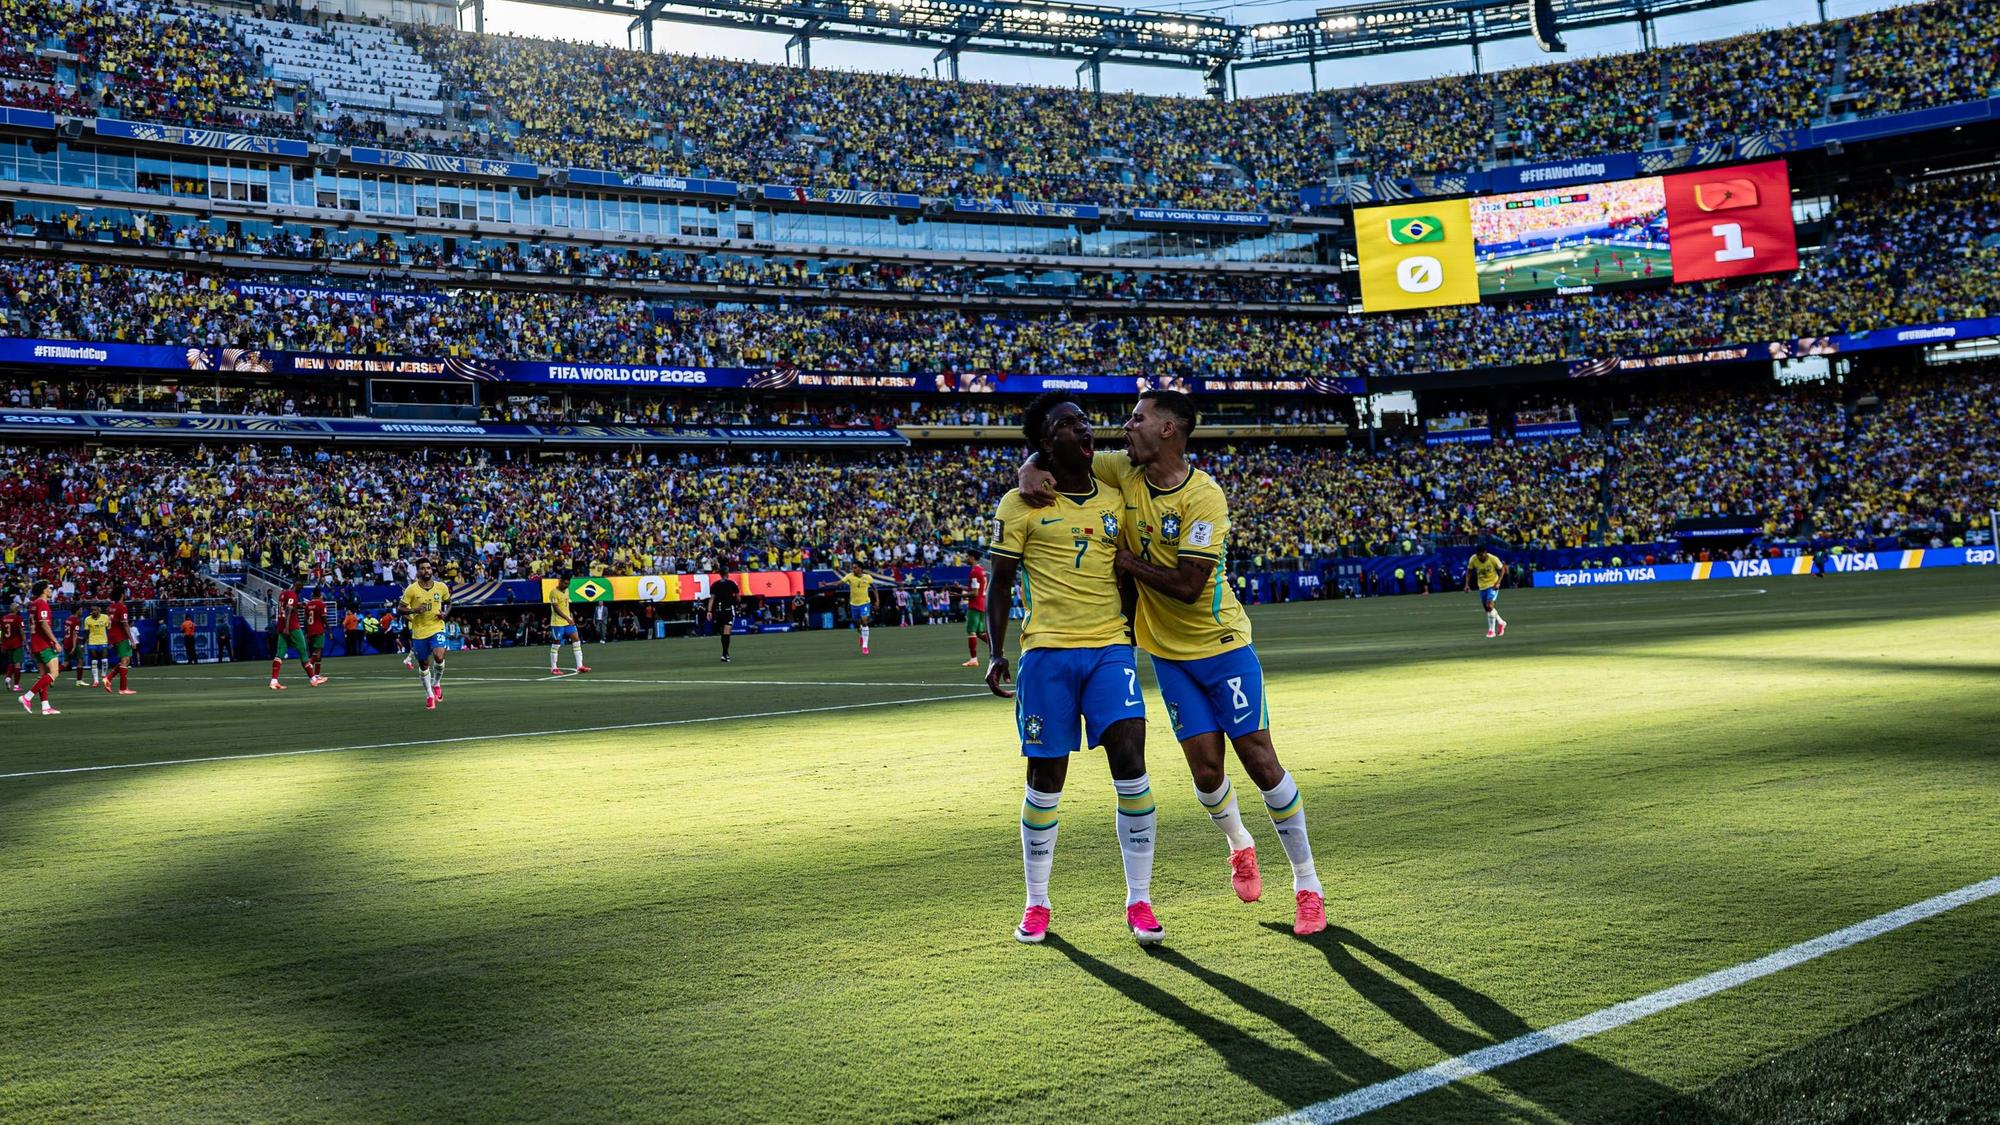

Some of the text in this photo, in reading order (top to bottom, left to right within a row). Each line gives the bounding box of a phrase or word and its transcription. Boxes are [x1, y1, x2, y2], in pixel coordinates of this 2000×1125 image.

[1520, 163, 1605, 183] #FIFAWorldCup
[623, 175, 687, 191] #FAWorldCup
[1140, 210, 1164, 218] NEW
[1166, 211, 1195, 219] YORK
[1197, 213, 1221, 221] NEW
[1712, 223, 1755, 262] 1
[1396, 255, 1444, 293] 0
[1557, 285, 1593, 295] Hisense
[34, 345, 107, 361] #FIFAWorldCup
[1620, 348, 1747, 369] NEW YORK NEW JERSEY
[294, 357, 444, 374] NEW YORK NEW JERSEY
[549, 366, 706, 383] FIFA WORLD CUP 2026
[798, 374, 916, 387] NEW YORK NEW JERSEY
[1205, 380, 1307, 390] NEW YORK NEW JERSEY
[3, 415, 76, 424] 2026
[380, 424, 486, 434] #FIFAWorldCup
[1075, 540, 1088, 568] 7
[1784, 547, 1803, 557] FIF
[1965, 548, 1995, 564] tap
[1727, 559, 1772, 577] VISA
[1830, 552, 1878, 572] VISA
[1298, 575, 1320, 587] FIFA
[1554, 567, 1656, 586] tap in with VISA
[637, 575, 666, 601] 0
[5, 623, 11, 638] 3
[1124, 668, 1136, 696] 7
[1227, 676, 1249, 710] 8
